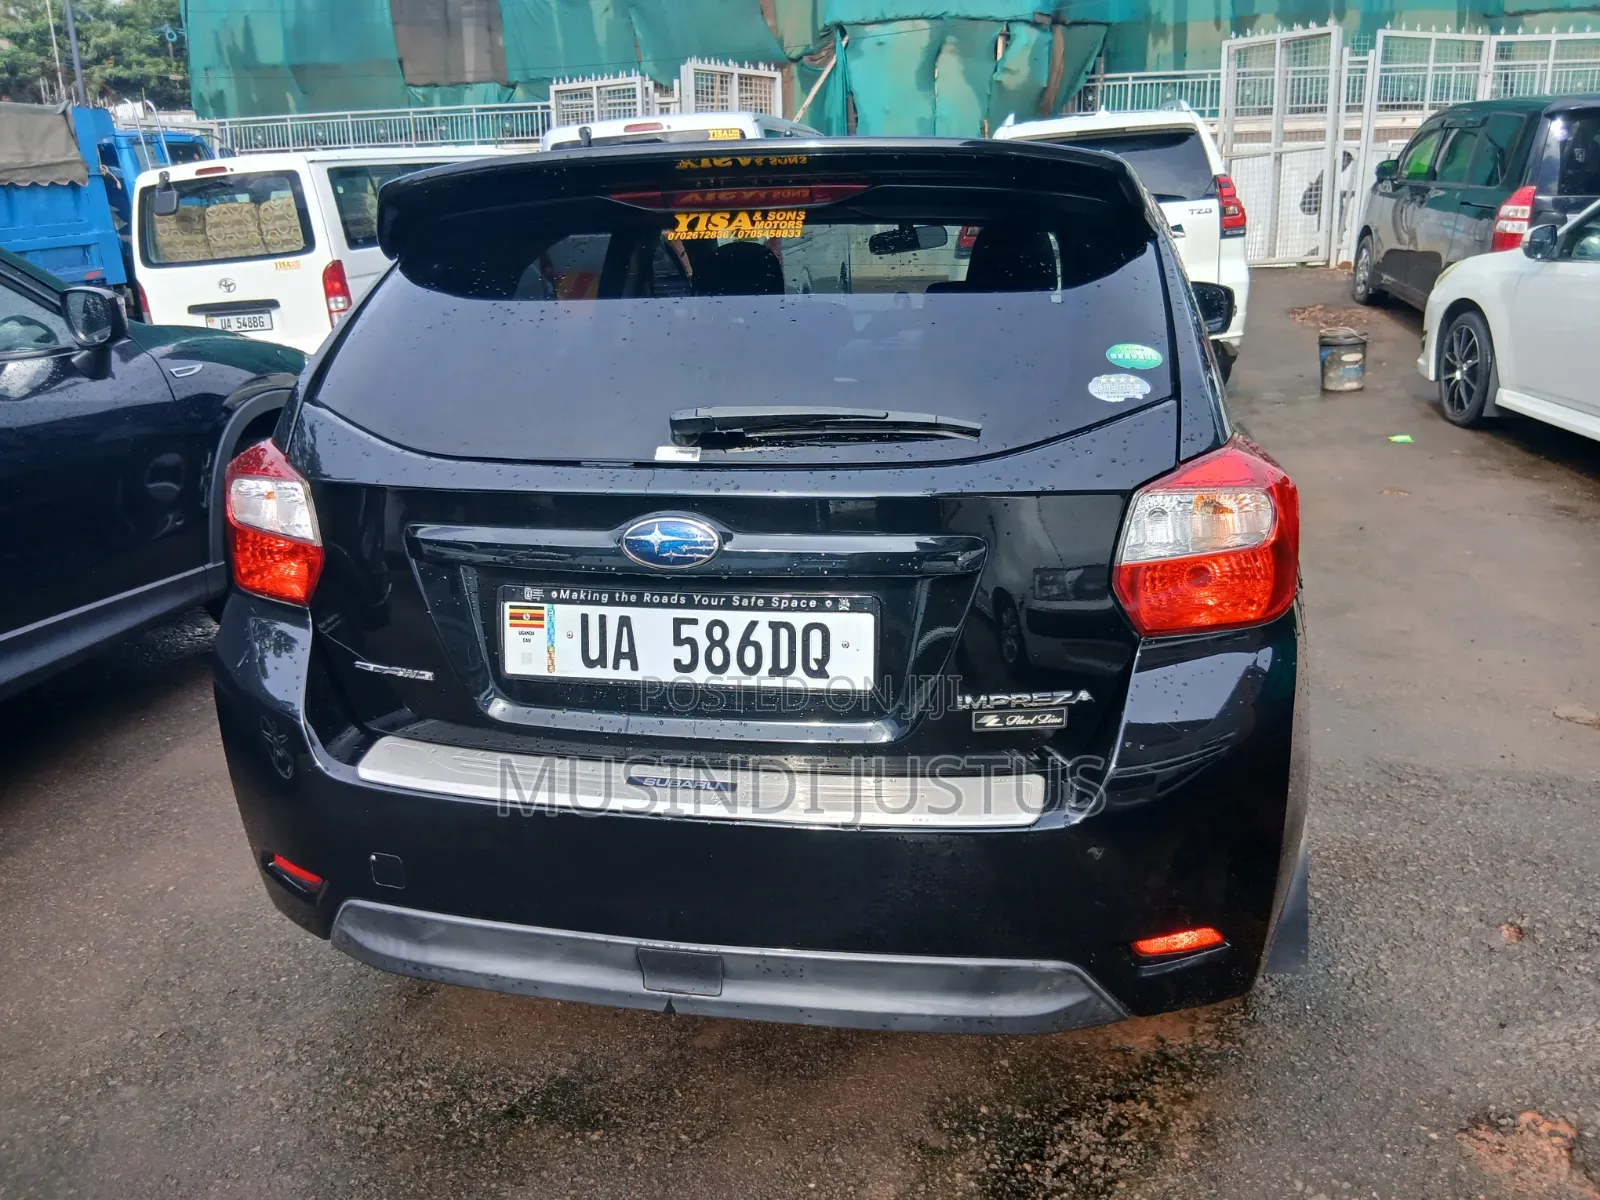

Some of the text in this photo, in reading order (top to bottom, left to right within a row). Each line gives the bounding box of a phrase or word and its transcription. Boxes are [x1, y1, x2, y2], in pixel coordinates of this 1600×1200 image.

[674, 210, 807, 232] YISA & SONS
[754, 220, 804, 230] MOTORS
[220, 316, 265, 330] UA 548BG
[559, 589, 609, 604] Making
[615, 591, 637, 602] the
[643, 592, 687, 604] Roads
[693, 594, 726, 606] Your
[732, 595, 765, 607] Safe
[771, 596, 817, 609] Space
[580, 612, 831, 679] UA 586DQ
[956, 689, 1096, 710] IMPREZA
[642, 777, 721, 791] SUBARU
